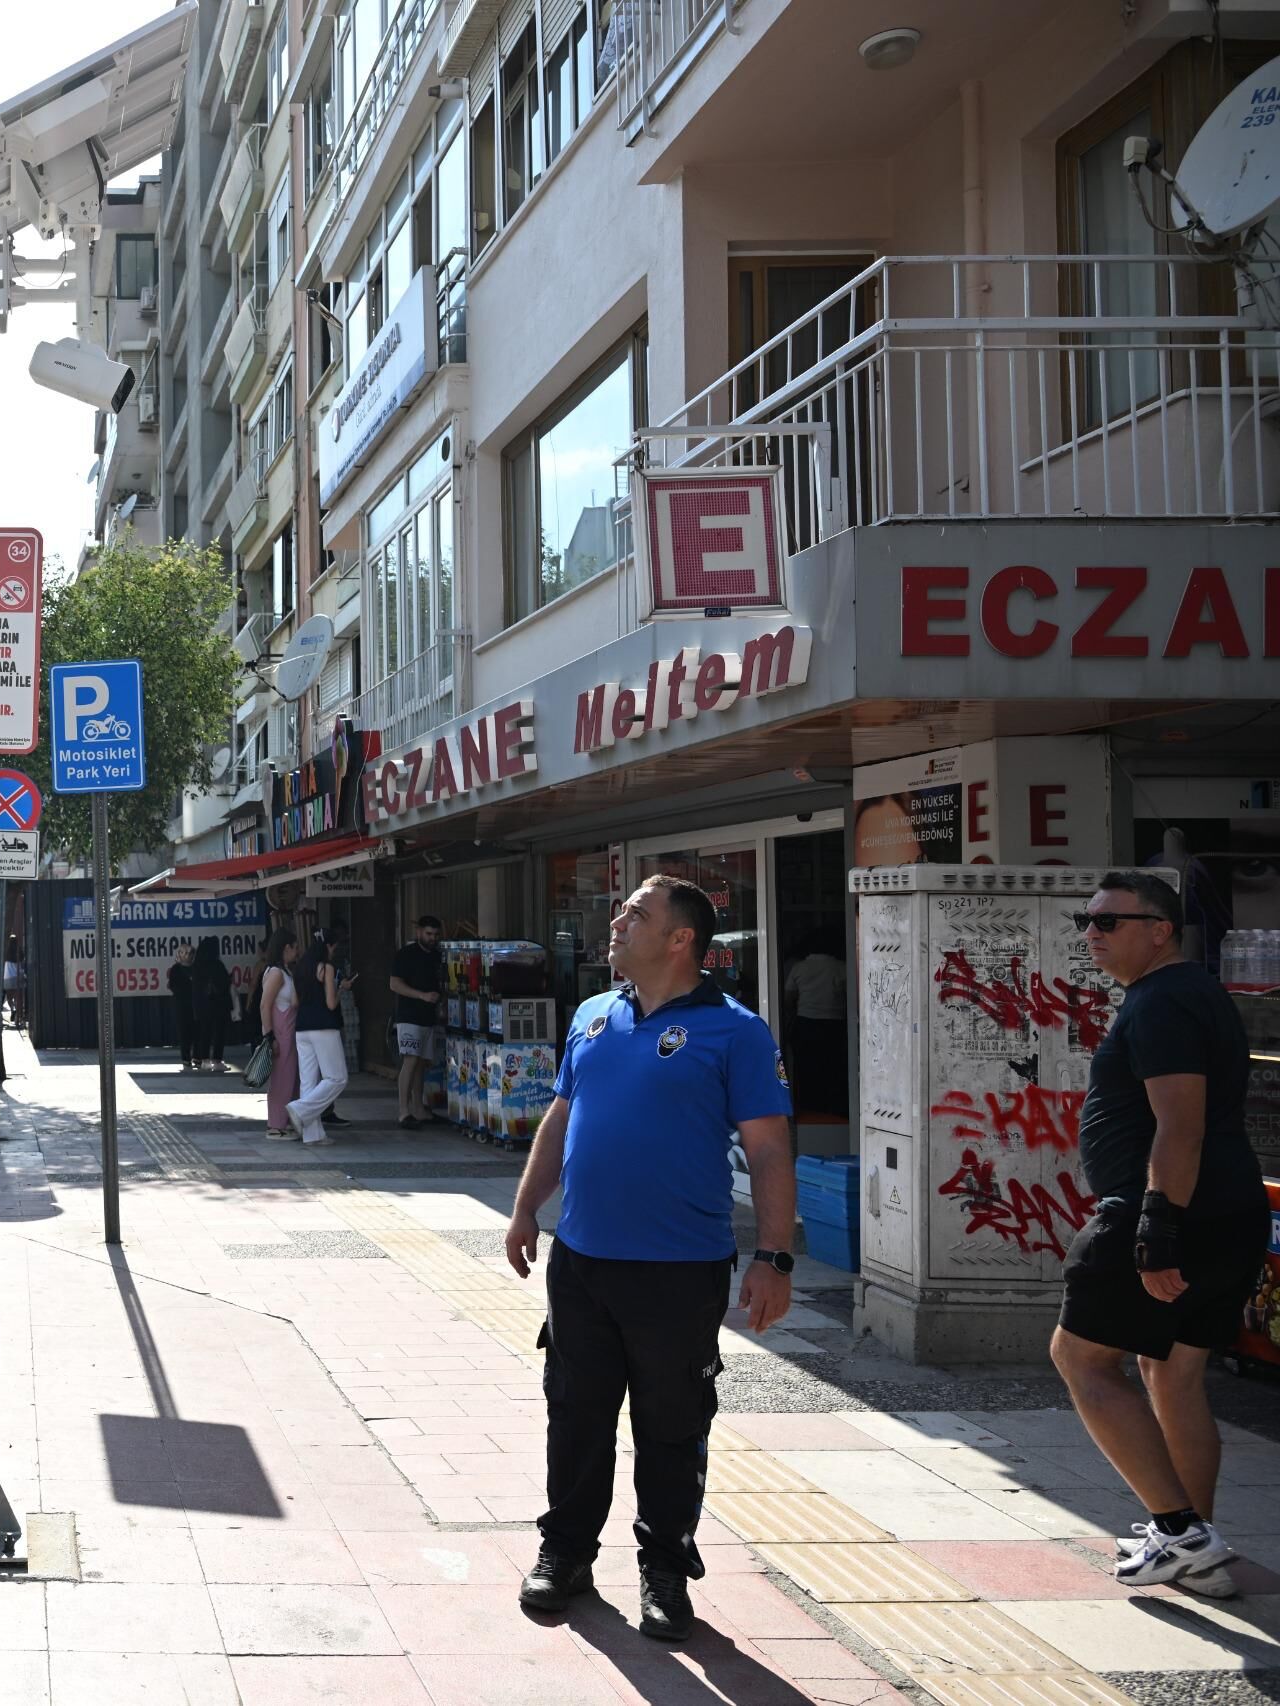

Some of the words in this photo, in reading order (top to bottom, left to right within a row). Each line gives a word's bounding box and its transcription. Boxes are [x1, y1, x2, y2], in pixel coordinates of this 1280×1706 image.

[1240, 113, 1275, 128] 239
[11, 545, 28, 557] 34
[660, 487, 767, 598] E
[901, 566, 1280, 658] ECZA
[16, 673, 32, 688] İLE
[63, 675, 109, 741] P
[361, 701, 537, 824] ECZANE
[573, 625, 812, 755] Meltem
[59, 747, 137, 763] Motosiklet
[67, 765, 99, 780] Park
[102, 764, 131, 779] Yeri
[911, 799, 922, 810] EN
[923, 793, 955, 808] YÜKSEK
[275, 792, 333, 849] DONDURMA
[173, 902, 195, 920] 45
[200, 901, 228, 919] LTD
[234, 899, 257, 922] ŞTİ
[117, 968, 159, 991] 0533
